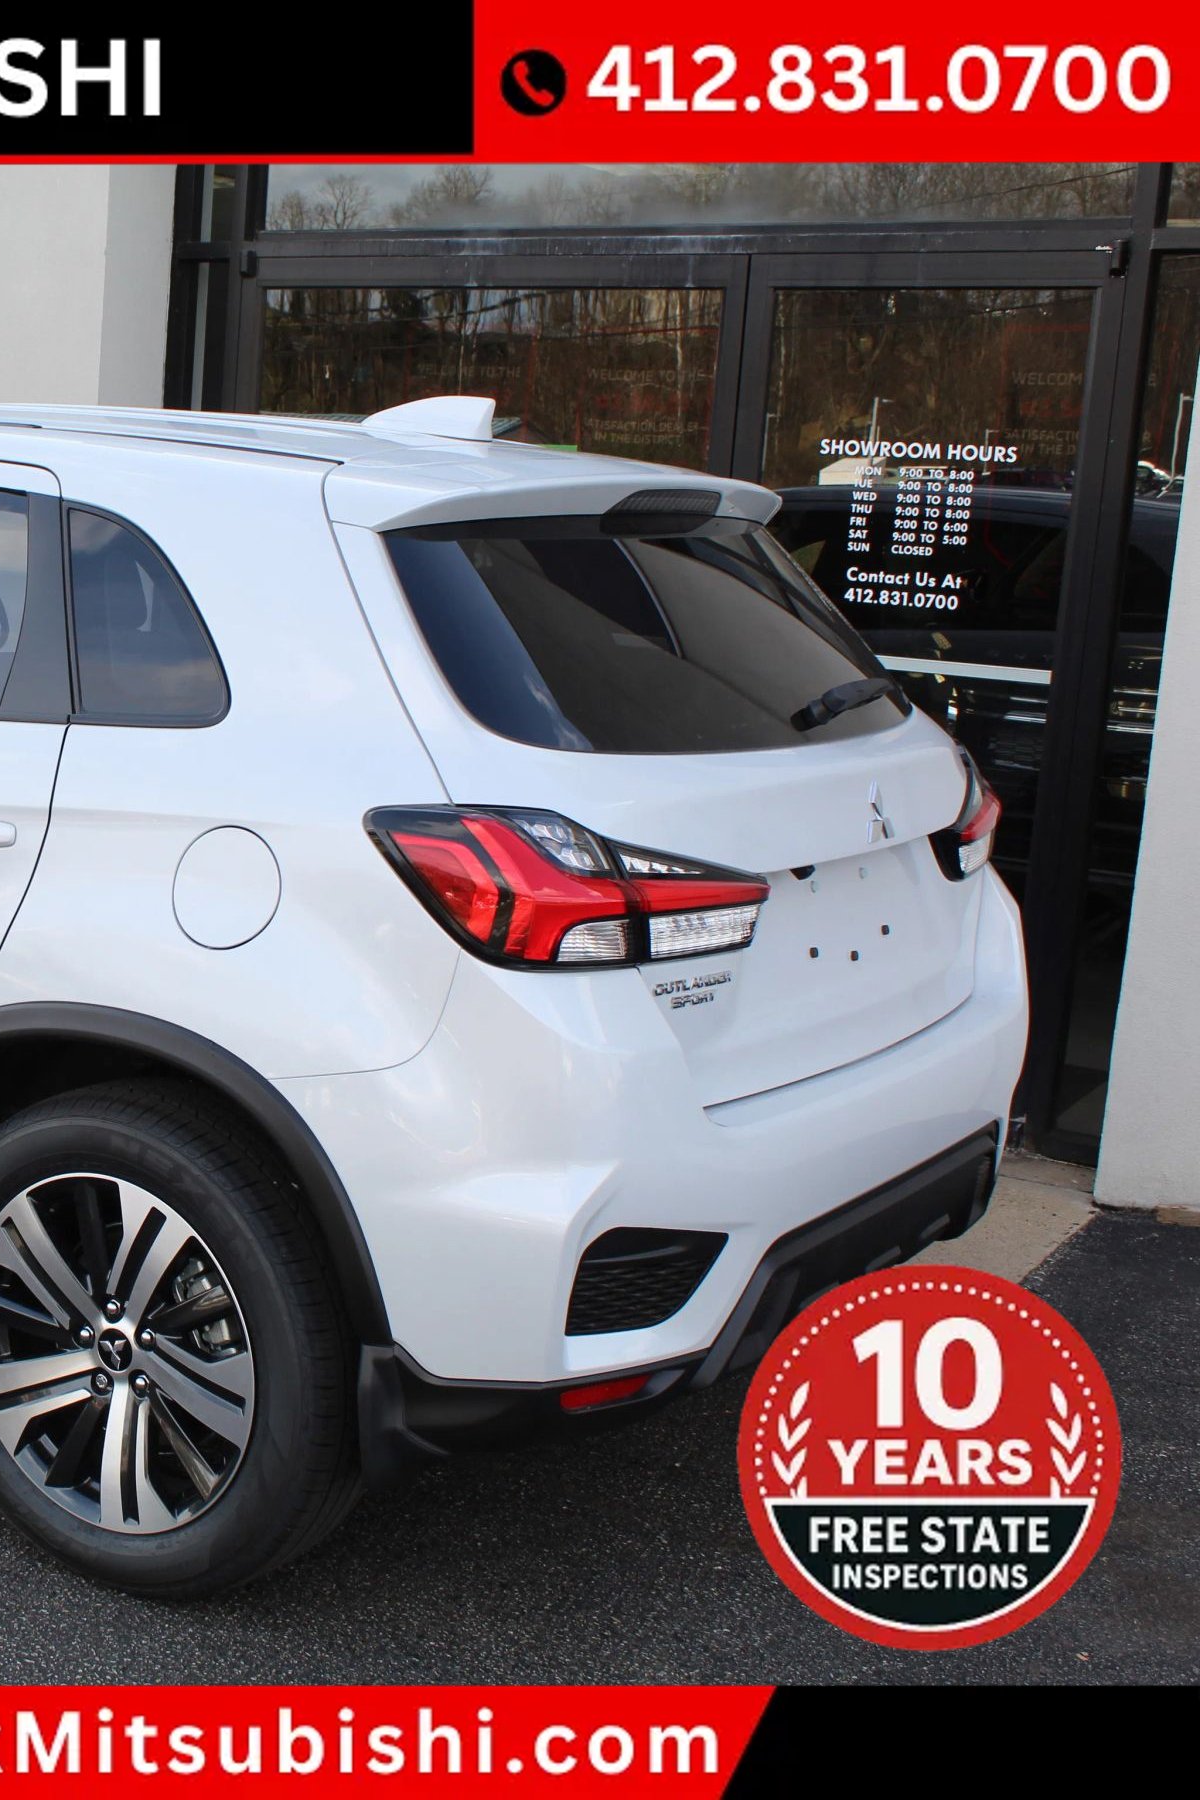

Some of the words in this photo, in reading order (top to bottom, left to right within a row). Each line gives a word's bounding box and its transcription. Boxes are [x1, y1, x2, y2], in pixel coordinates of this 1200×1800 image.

[586, 368, 654, 383] WELCOME
[1012, 372, 1083, 386] WELCOM
[819, 439, 940, 460] SHOWROOM
[947, 443, 1018, 464] HOURS
[1042, 444, 1064, 456] THE
[855, 466, 882, 476] MON
[900, 468, 923, 478] 9:00
[929, 469, 944, 479] TO
[949, 470, 974, 480] 8:00
[854, 479, 873, 489] TUE
[898, 481, 921, 491] 9:00
[926, 482, 941, 492] TO
[948, 483, 973, 493] 8:00
[852, 491, 877, 501] WED
[896, 493, 920, 503] 9:00
[926, 495, 941, 505] TO
[946, 496, 971, 506] 8:00
[851, 504, 873, 514] THU
[895, 506, 919, 516] 9:00
[925, 508, 940, 518] TO
[945, 509, 970, 519] 8:00
[849, 516, 867, 526] FRI
[894, 519, 917, 529] 9:00
[923, 521, 938, 531] TO
[943, 522, 968, 533] 6:00
[848, 529, 868, 539] SAT
[892, 532, 915, 542] 9:00
[920, 533, 935, 543] TO
[942, 535, 967, 545] 5:00
[847, 542, 870, 552] SUN
[891, 545, 933, 556] CLOSED
[846, 567, 910, 586] Contact
[916, 572, 936, 588] Us
[941, 573, 962, 589] At
[844, 587, 959, 611] 412.831.0700
[653, 970, 732, 997] OUTLANDER
[670, 990, 715, 1009] SPORT
